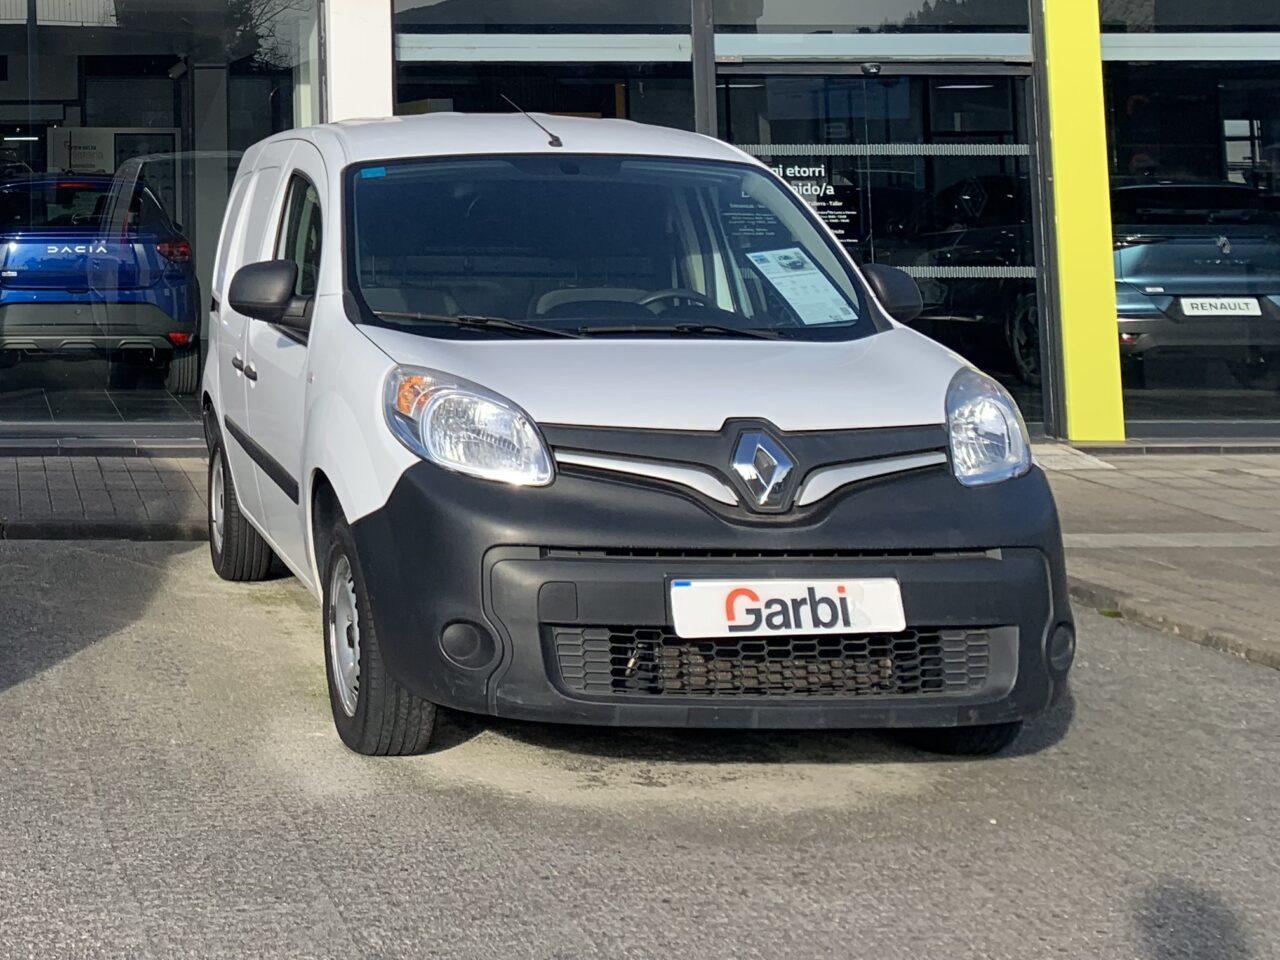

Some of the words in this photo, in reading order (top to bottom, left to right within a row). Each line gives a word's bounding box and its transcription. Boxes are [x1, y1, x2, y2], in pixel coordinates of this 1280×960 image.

[786, 164, 825, 177] etorri
[47, 245, 108, 254] DACIA
[1190, 302, 1251, 312] RENAULT
[725, 585, 852, 633] Garbi
